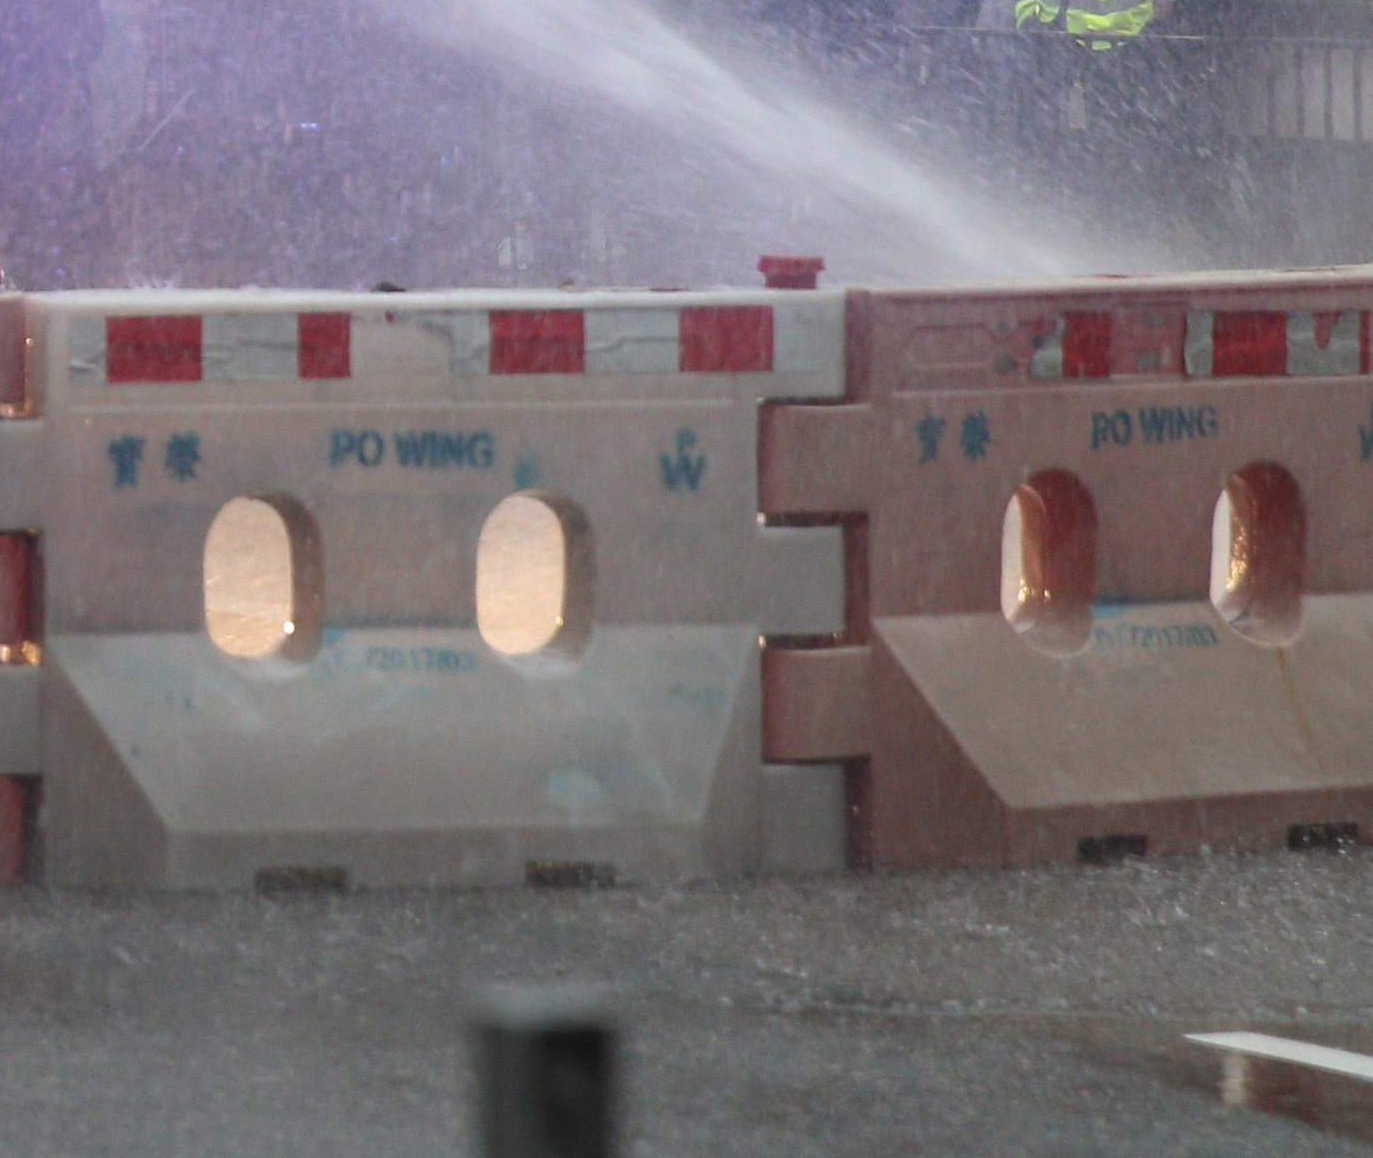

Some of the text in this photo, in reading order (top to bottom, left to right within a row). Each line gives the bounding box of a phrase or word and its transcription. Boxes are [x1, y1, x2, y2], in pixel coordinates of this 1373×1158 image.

[327, 427, 496, 471] PO WING
[1090, 404, 1220, 453] PO WING
